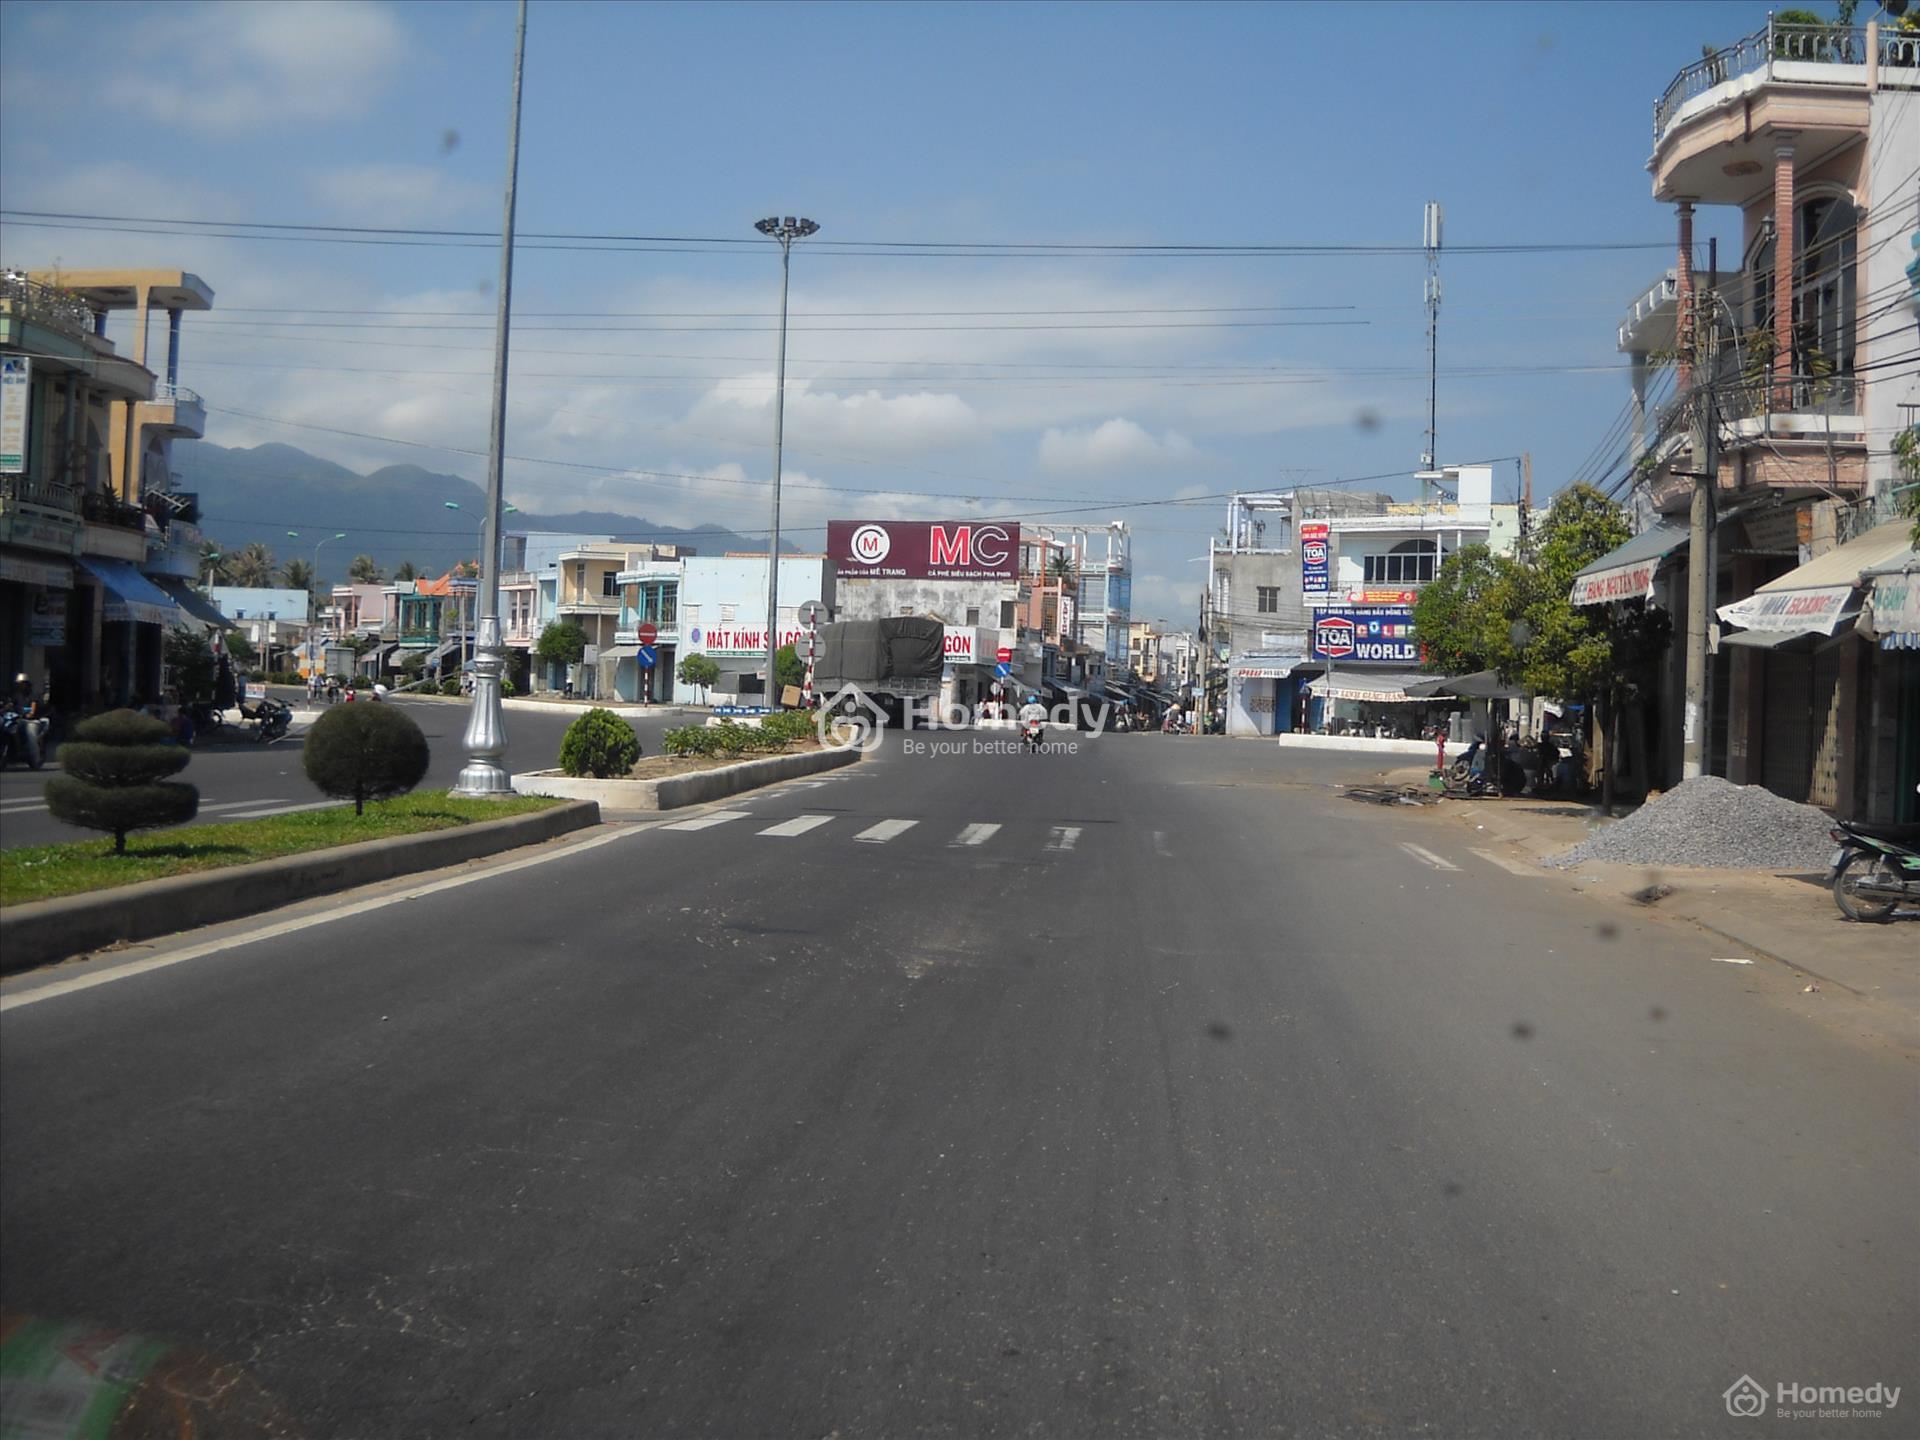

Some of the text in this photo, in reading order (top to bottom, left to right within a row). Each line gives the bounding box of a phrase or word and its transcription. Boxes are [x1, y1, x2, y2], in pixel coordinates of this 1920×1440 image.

[929, 525, 1009, 567] MC
[1306, 548, 1324, 557] TOA
[882, 568, 906, 577] TRANG
[733, 626, 760, 649] KÍNH
[1319, 629, 1351, 645] TOA
[1356, 643, 1416, 659] WORLD
